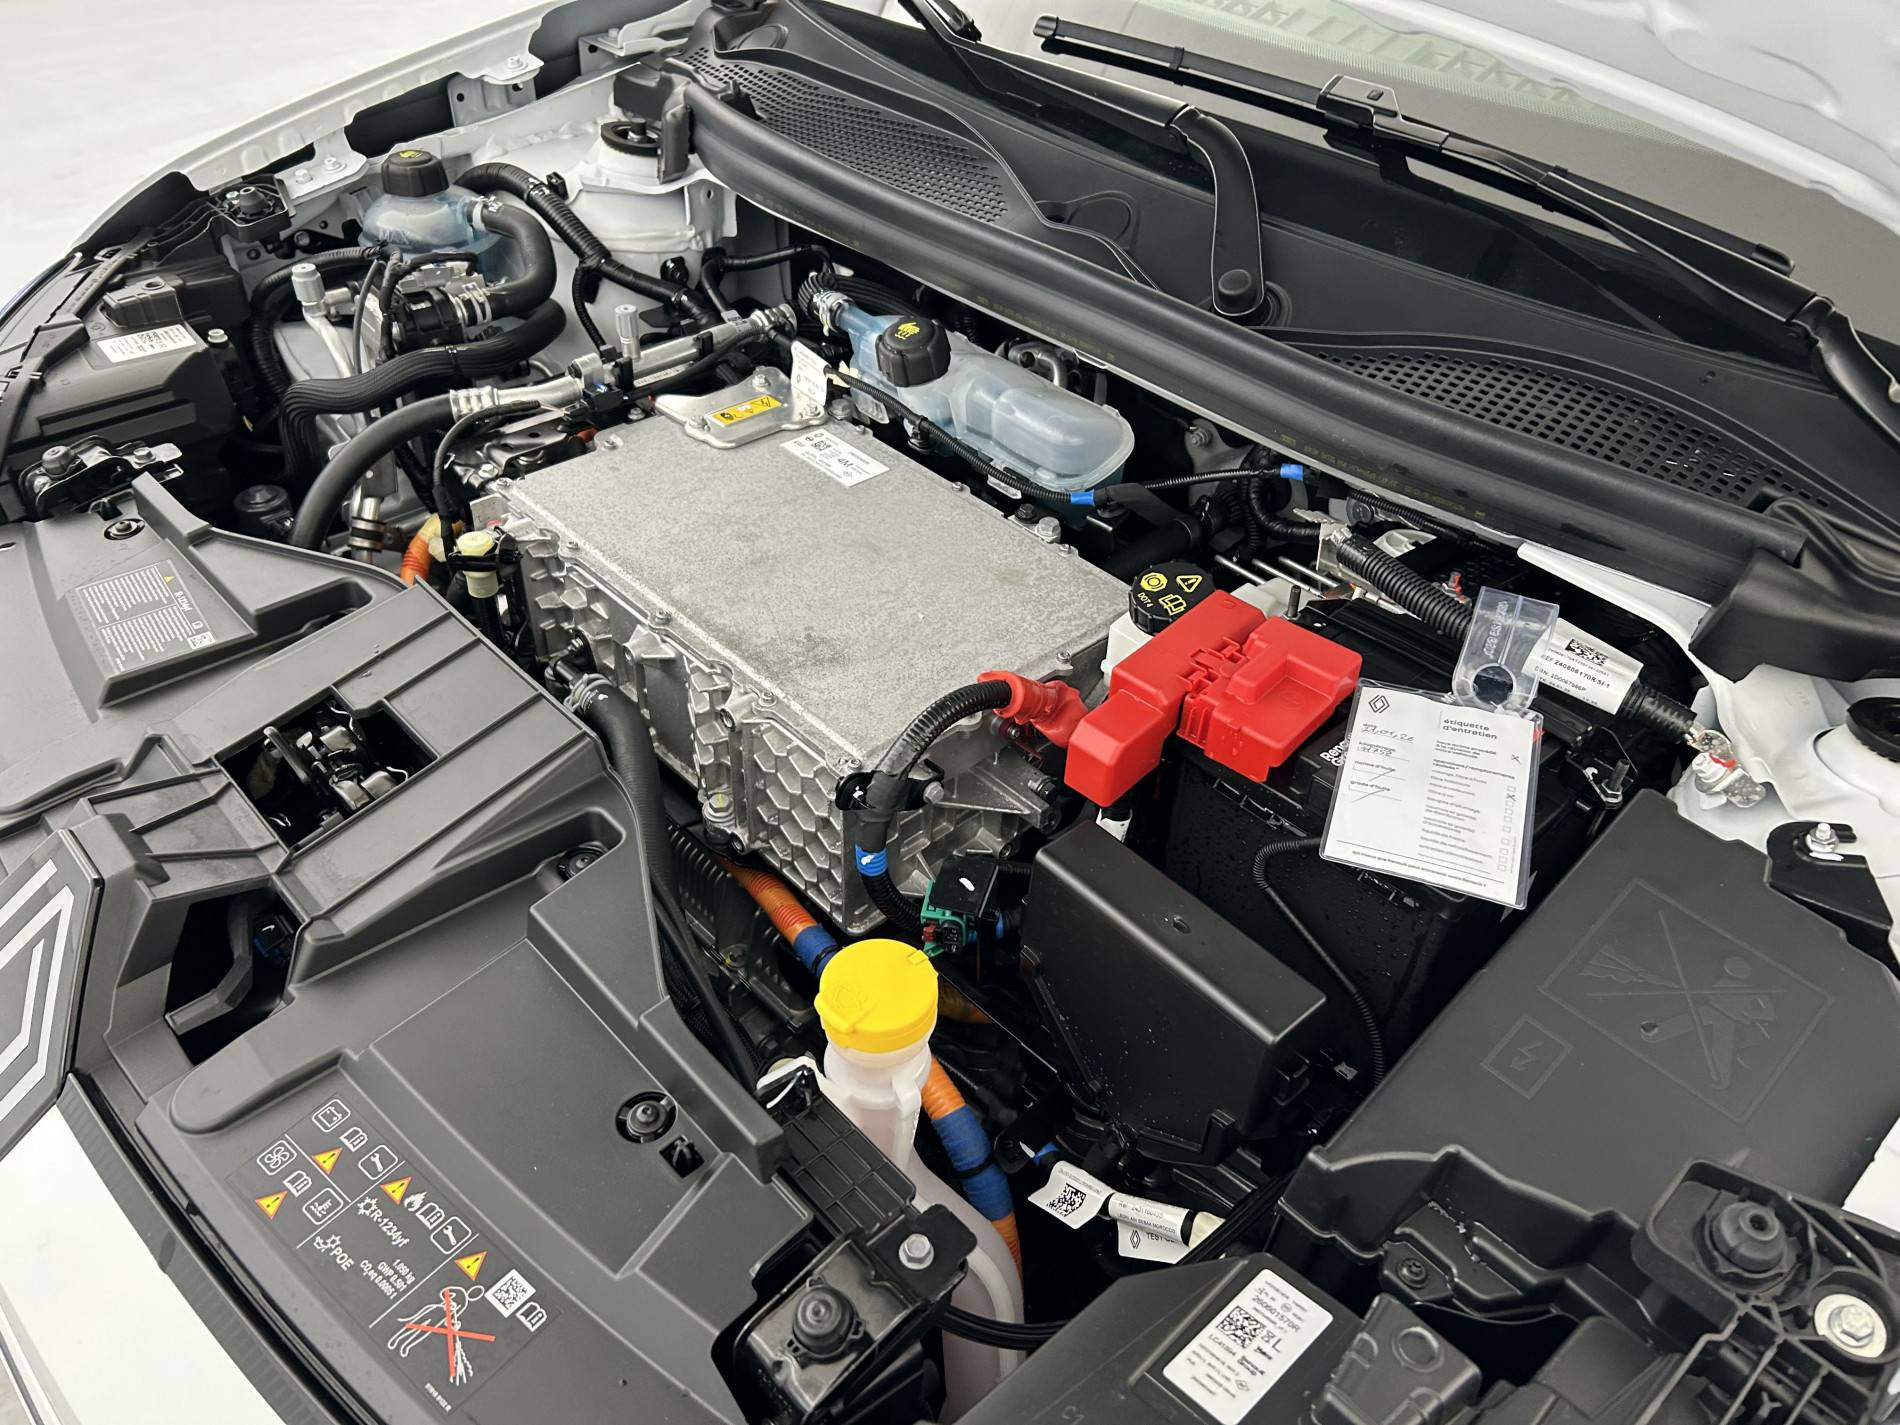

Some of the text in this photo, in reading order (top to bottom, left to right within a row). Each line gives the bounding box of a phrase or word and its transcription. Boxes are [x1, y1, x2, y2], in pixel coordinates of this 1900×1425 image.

[1137, 592, 1151, 604] DOT
[1442, 724, 1498, 740] d'entretien
[1443, 718, 1490, 731] étiquette
[370, 1209, 410, 1247] R-1234yf
[329, 1246, 354, 1272] POE
